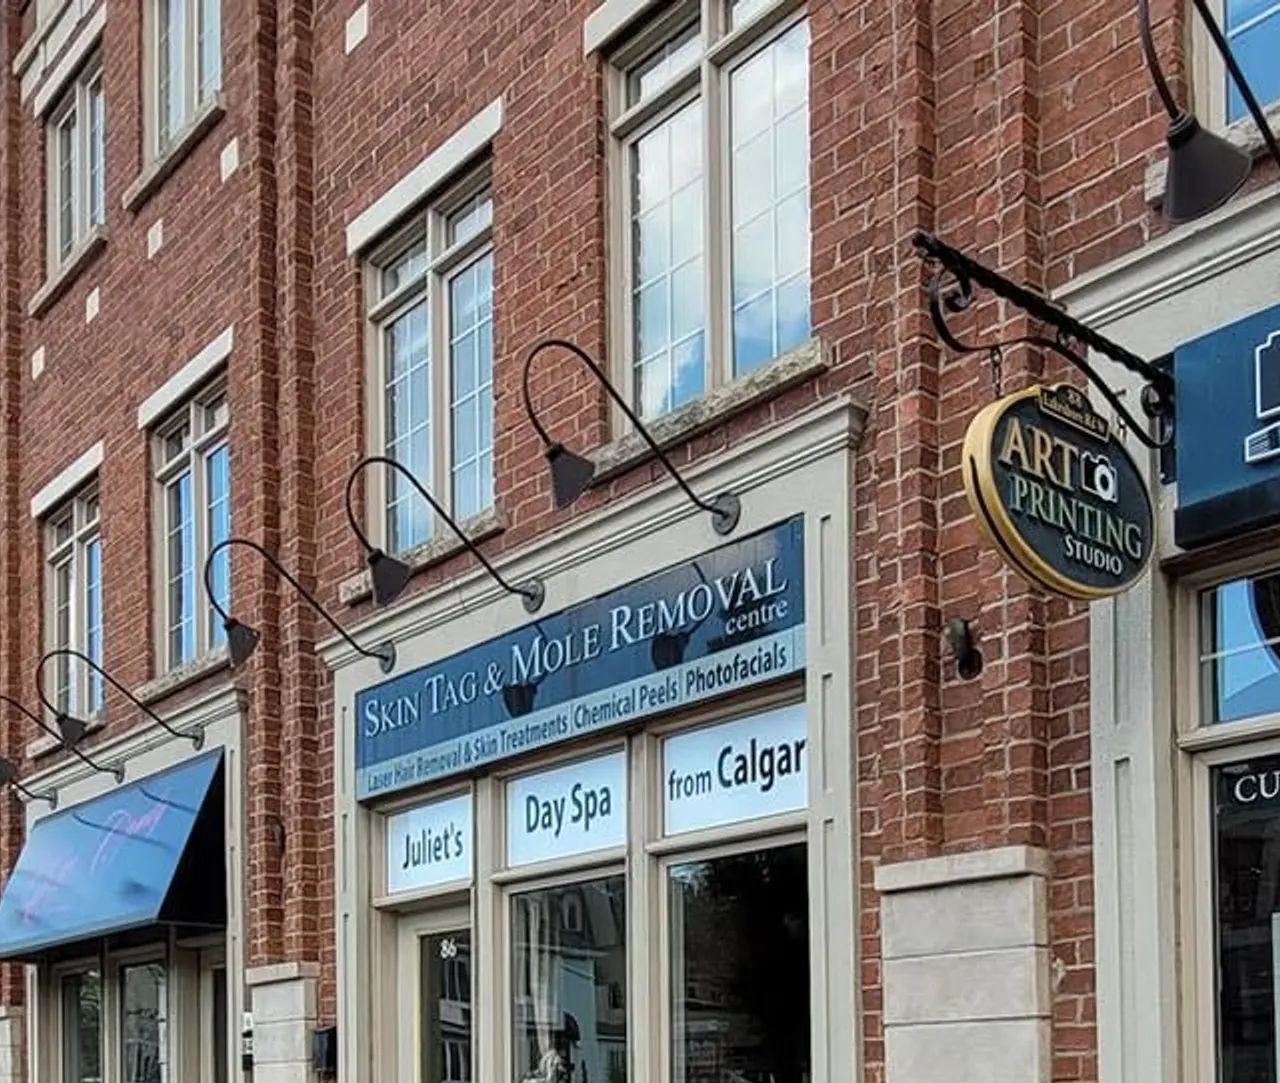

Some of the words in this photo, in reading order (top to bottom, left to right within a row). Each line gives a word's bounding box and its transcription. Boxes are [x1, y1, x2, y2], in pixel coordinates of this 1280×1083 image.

[998, 416, 1079, 491] ART
[1008, 473, 1142, 559] PRINTING
[1064, 534, 1122, 576] STUDIO
[365, 690, 421, 738] SKIN
[425, 671, 477, 714] TAG
[483, 661, 504, 696] &
[511, 623, 601, 686] MOLE
[609, 557, 789, 652] REMOVAL
[725, 599, 789, 636] centre
[473, 735, 497, 761] Skin
[499, 713, 569, 752] Treatments
[573, 688, 636, 730] Chemical
[639, 677, 678, 709] Peels
[685, 640, 787, 696] Photofacials
[402, 820, 464, 870] Juliet's
[525, 792, 564, 838] Day
[571, 782, 612, 830] Spa
[668, 769, 712, 801] from
[440, 938, 457, 959] 86
